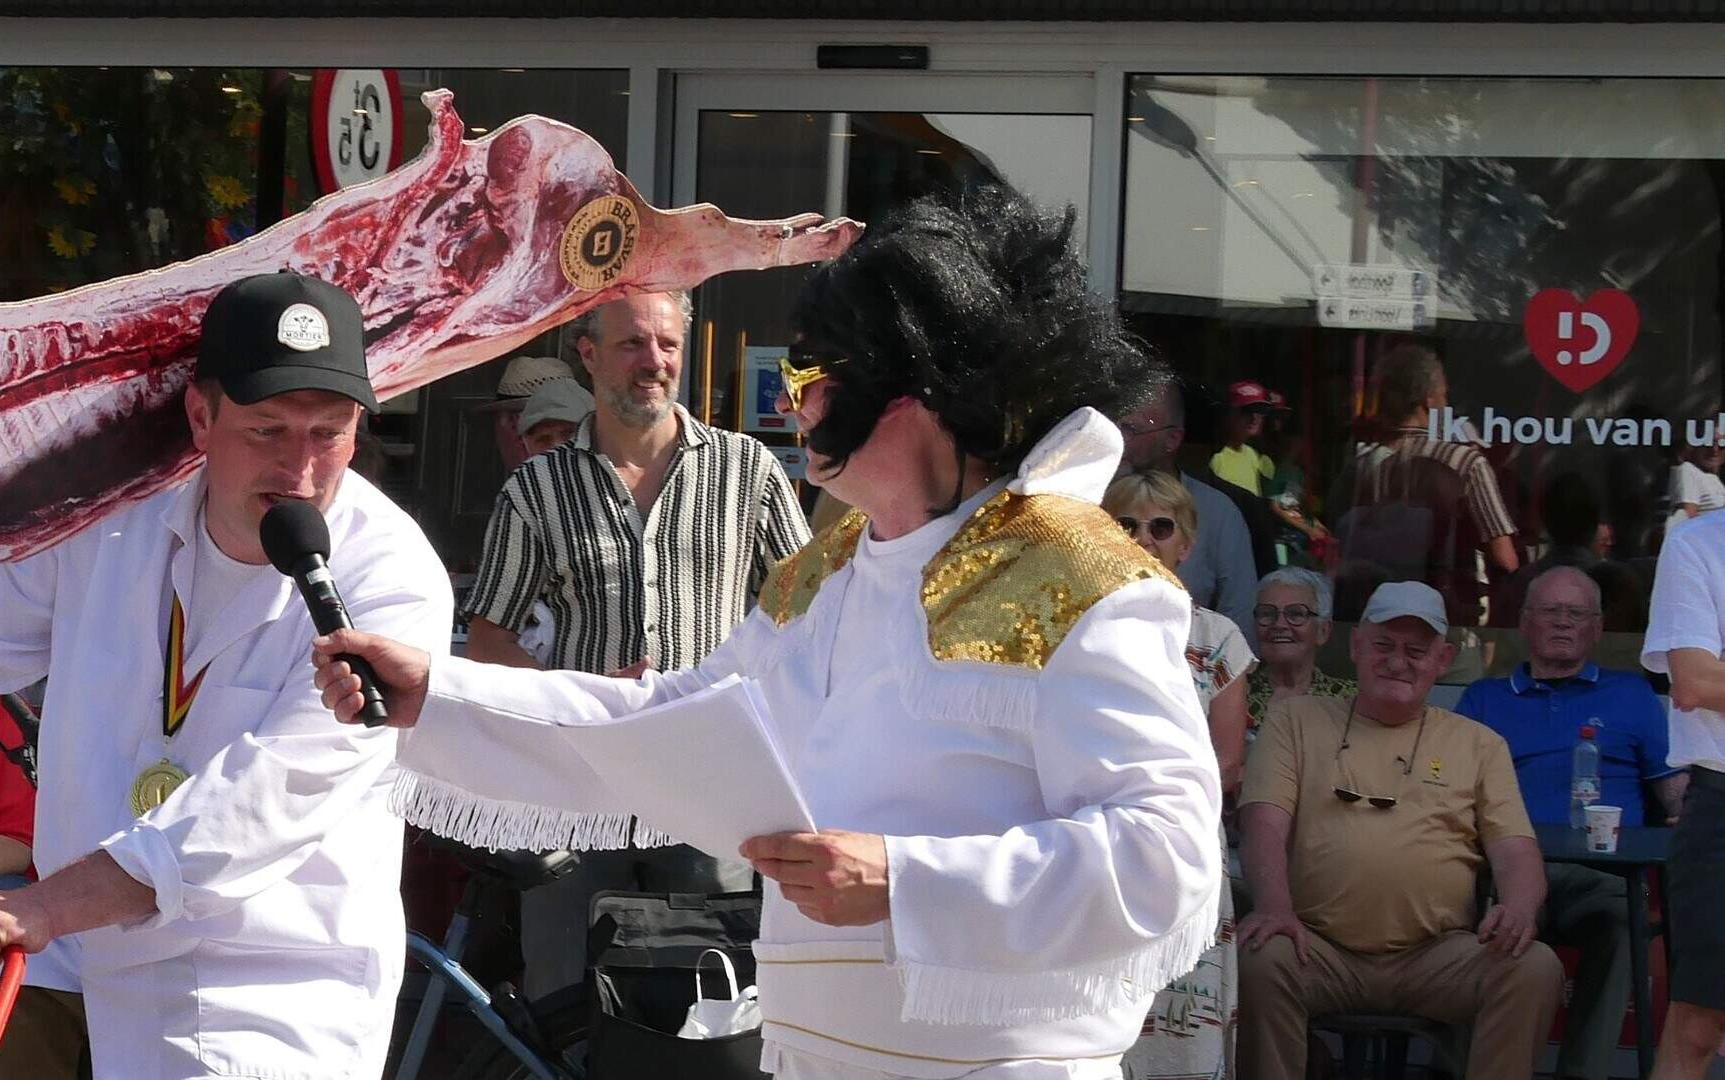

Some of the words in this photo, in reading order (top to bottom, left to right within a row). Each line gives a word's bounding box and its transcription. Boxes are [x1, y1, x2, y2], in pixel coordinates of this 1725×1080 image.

[1428, 406, 1471, 444] Ik
[1482, 406, 1572, 445] hou
[1585, 417, 1672, 447] van
